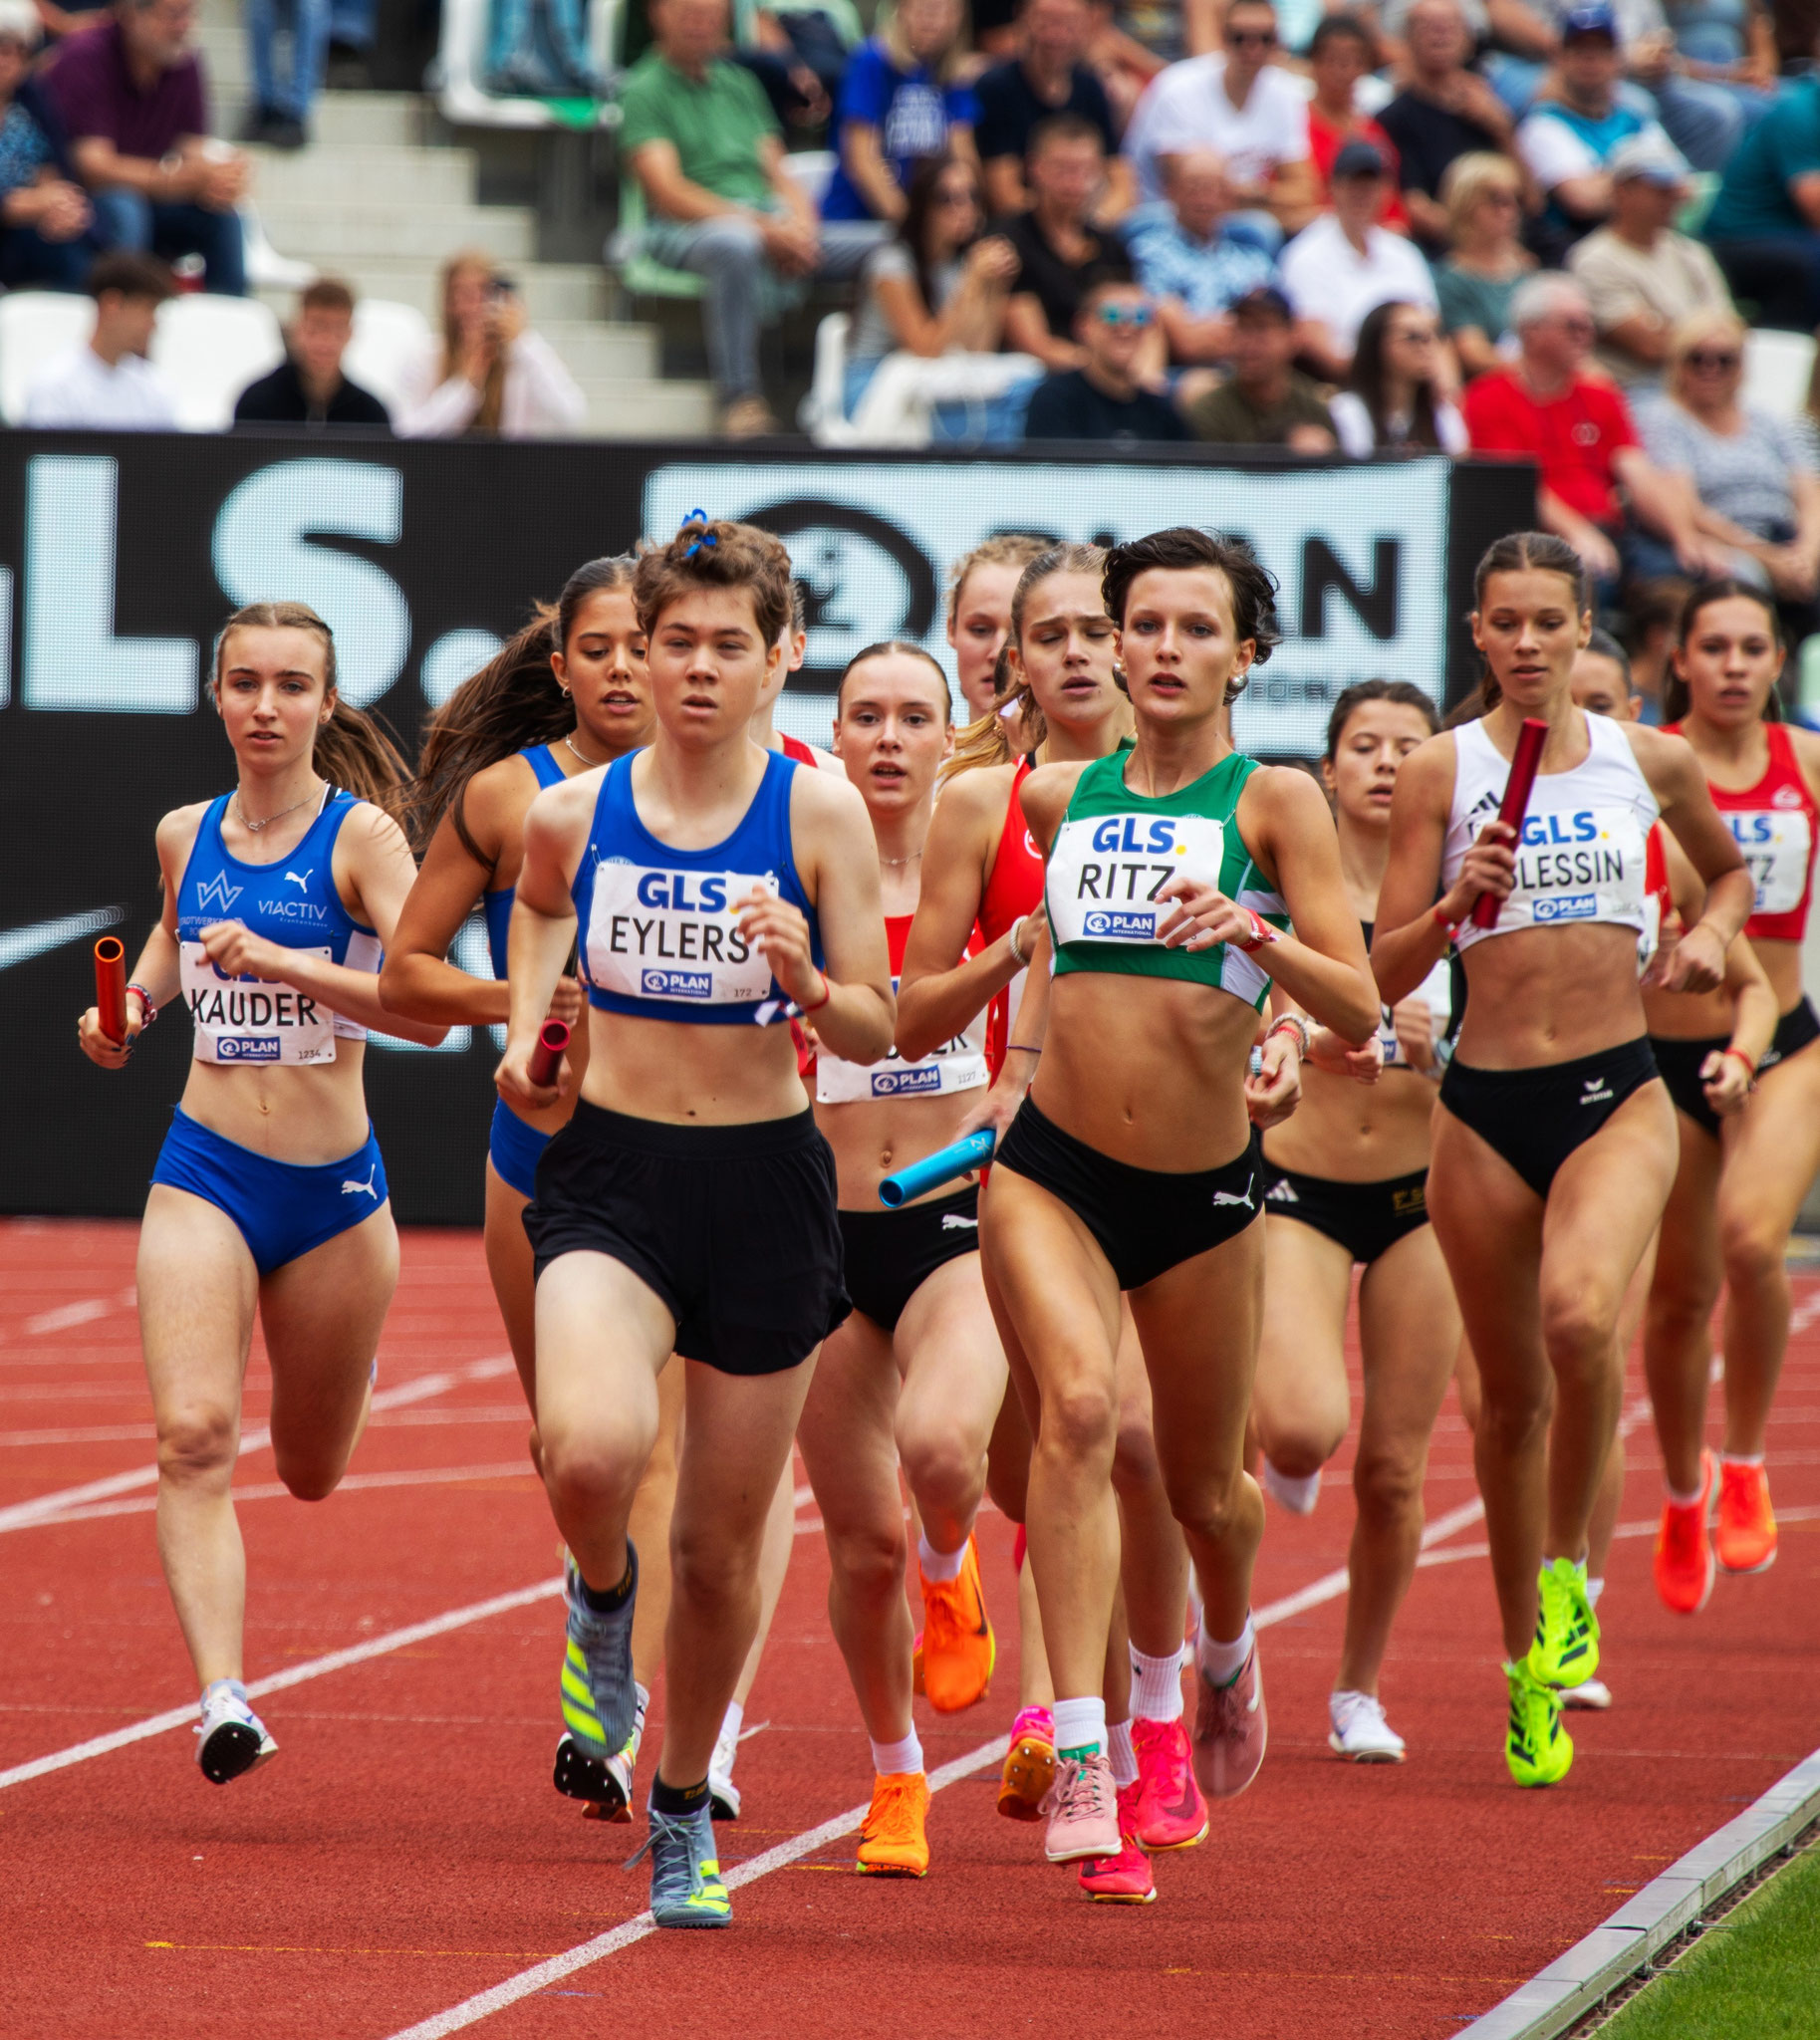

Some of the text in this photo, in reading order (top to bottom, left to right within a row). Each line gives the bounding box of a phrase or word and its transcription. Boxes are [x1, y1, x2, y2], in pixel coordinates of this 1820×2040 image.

[0, 454, 504, 716] LS.
[1092, 818, 1187, 856] GLS.
[1521, 812, 1610, 847] GLS.
[1733, 817, 1783, 843] LS.
[1078, 863, 1175, 902] RITZ
[1512, 849, 1624, 891] LESSIN
[258, 899, 328, 920] VIACTIV
[1113, 914, 1153, 930] PLAN
[610, 914, 749, 963] EYLERS
[669, 973, 709, 988] PLAN
[733, 988, 752, 997] 172
[191, 988, 319, 1027] KAUDER
[241, 1039, 278, 1053] PLAN
[298, 1050, 321, 1060] 1234
[900, 1070, 938, 1086] PLAN
